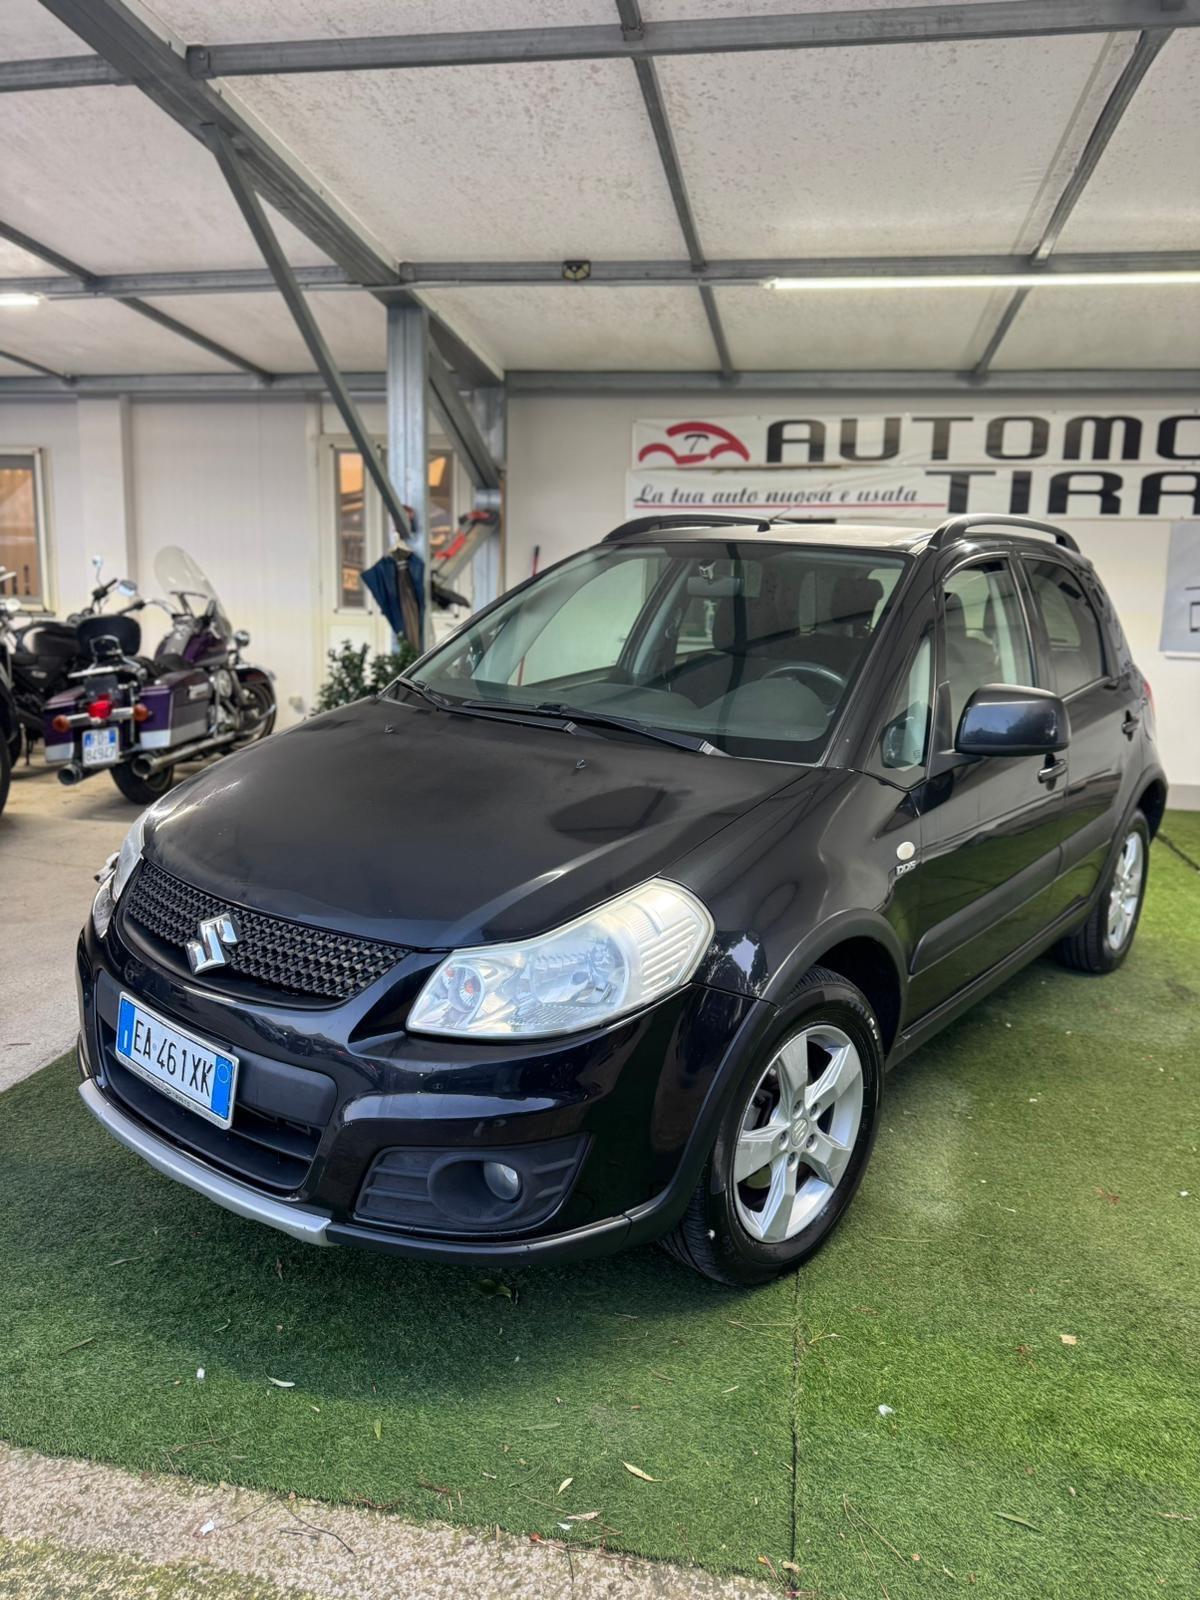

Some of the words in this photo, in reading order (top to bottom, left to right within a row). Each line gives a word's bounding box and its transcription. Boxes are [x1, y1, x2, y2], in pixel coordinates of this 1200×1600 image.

[634, 484, 663, 503] La
[671, 487, 704, 503] tua
[712, 487, 758, 503] auto
[840, 489, 850, 502] e
[857, 486, 917, 503] usata
